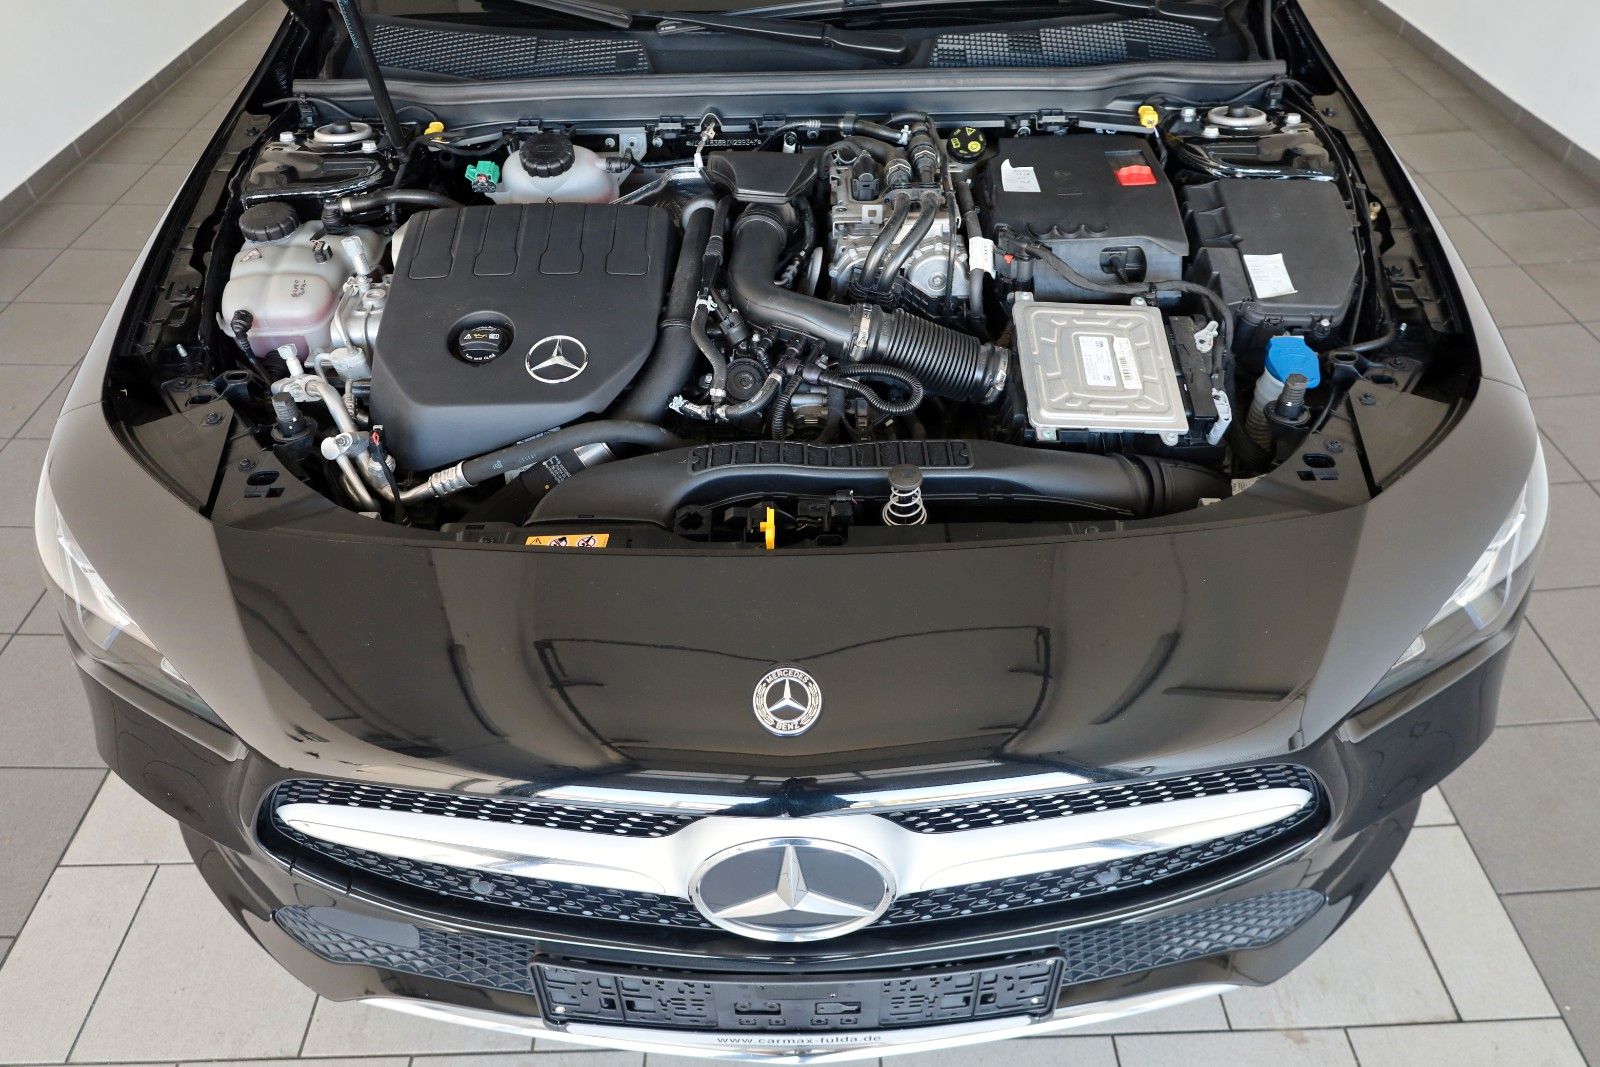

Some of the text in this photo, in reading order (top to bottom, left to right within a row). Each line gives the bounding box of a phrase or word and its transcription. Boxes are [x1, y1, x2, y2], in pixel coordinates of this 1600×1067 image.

[765, 669, 810, 683] MERCEDES
[776, 722, 801, 731] BENZ
[717, 1035, 881, 1044] www.carmax-fulda.de
